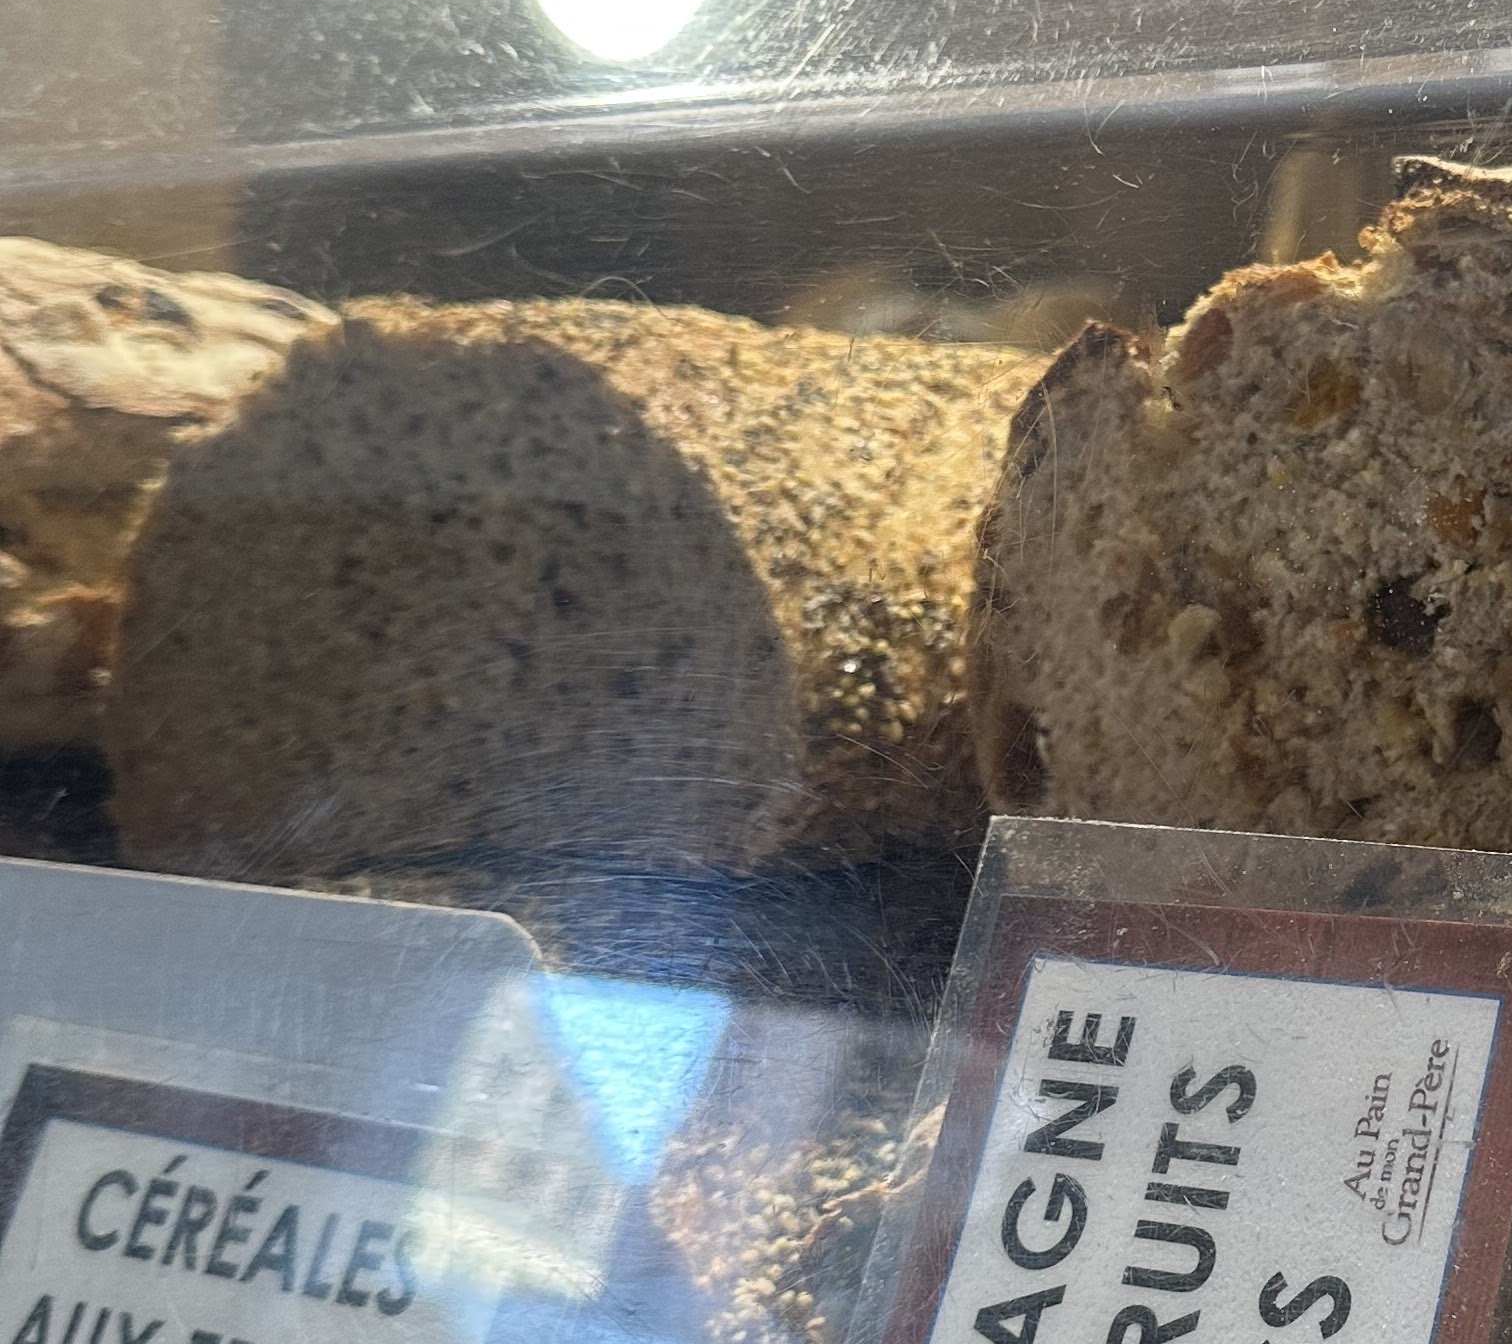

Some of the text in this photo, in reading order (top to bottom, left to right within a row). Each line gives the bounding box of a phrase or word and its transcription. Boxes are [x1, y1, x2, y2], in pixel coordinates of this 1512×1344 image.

[1344, 1072, 1392, 1201] Au Pain
[1370, 1138, 1399, 1210] de mon
[1382, 1039, 1449, 1245] Grand-Père
[77, 1155, 420, 1316] CÉRÉALES
